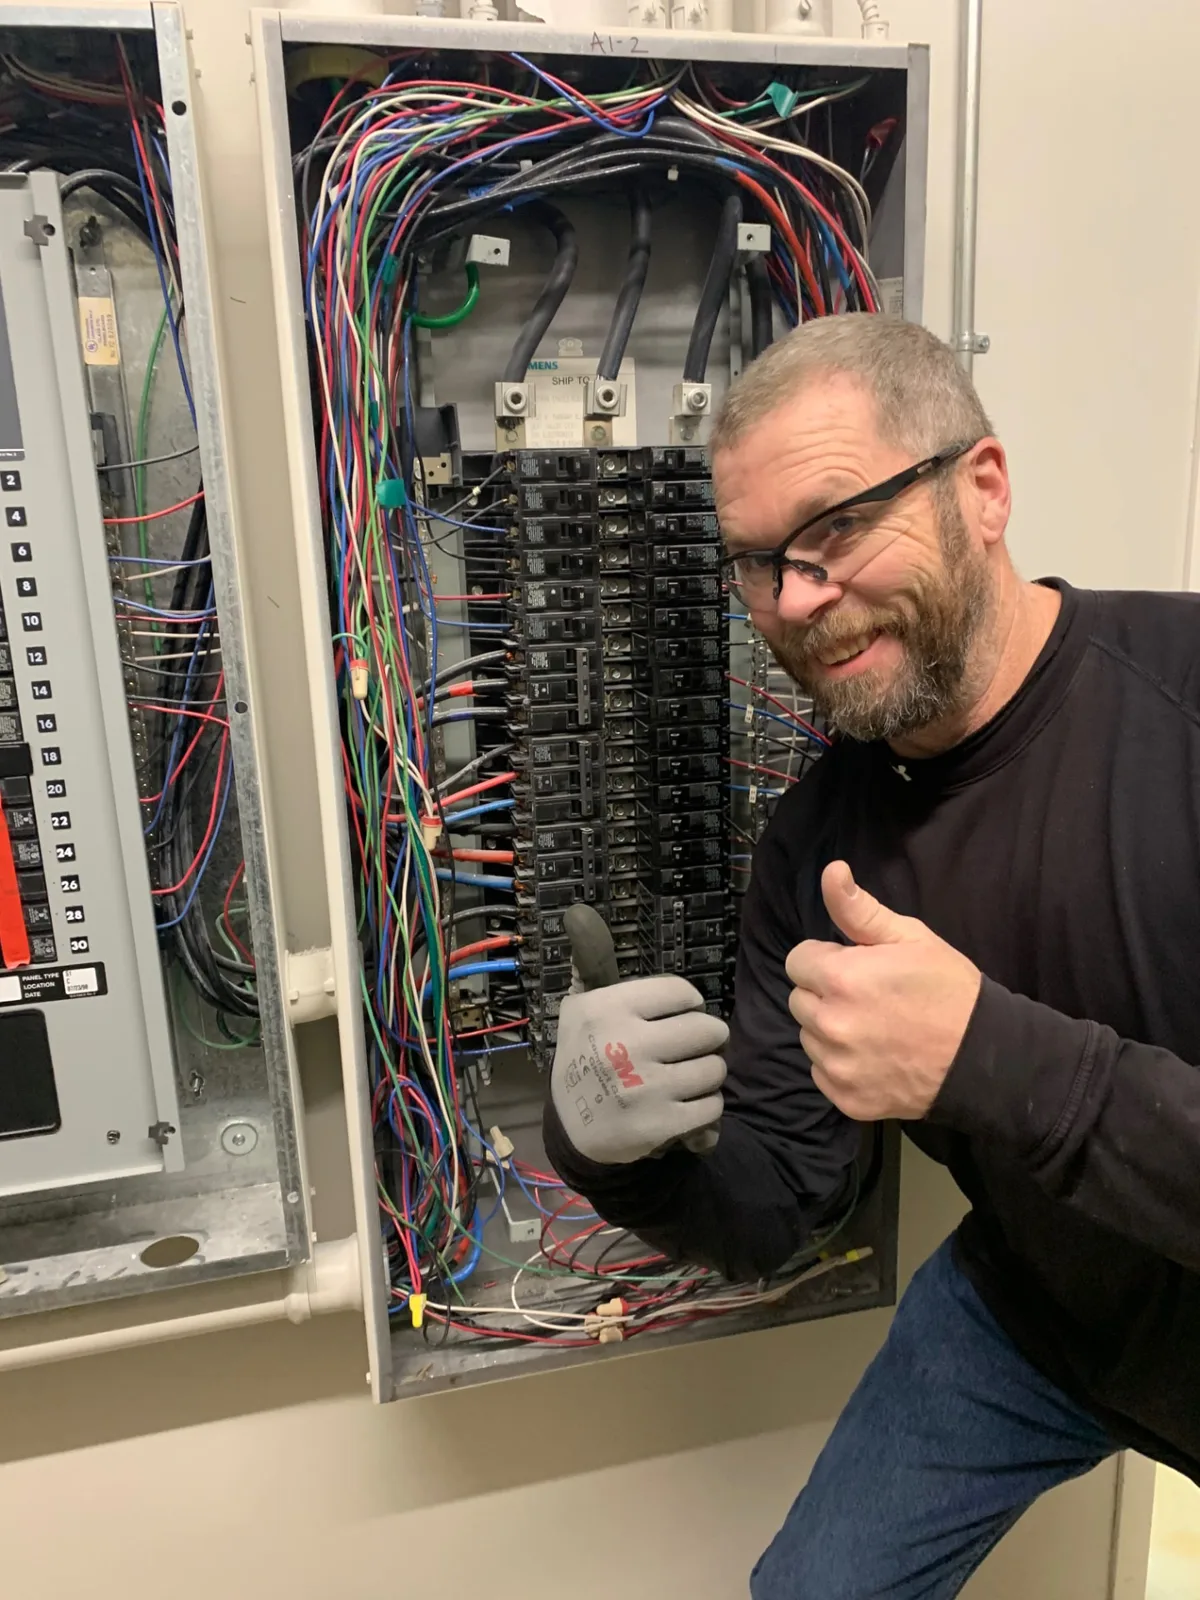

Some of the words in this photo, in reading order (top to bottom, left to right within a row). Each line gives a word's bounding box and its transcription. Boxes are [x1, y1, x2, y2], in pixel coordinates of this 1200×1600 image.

[528, 361, 558, 370] MENS
[552, 376, 573, 385] SHIP
[6, 475, 16, 486] 2
[11, 510, 21, 522] 4
[18, 545, 27, 557] 6
[22, 580, 31, 592] 8
[23, 615, 39, 627] 10
[28, 651, 43, 663] 12
[32, 685, 48, 697] 14
[38, 719, 53, 731] 16
[43, 752, 58, 763] 18
[47, 784, 63, 796] 20
[51, 815, 68, 827] 22
[56, 847, 74, 858] 24
[60, 879, 78, 891] 26
[65, 909, 83, 921] 28
[70, 939, 88, 951] 30
[24, 981, 55, 989] LOCATION
[588, 1034, 612, 1083] Comfort
[605, 1042, 645, 1088] 3M
[589, 1056, 610, 1096] Gloves
